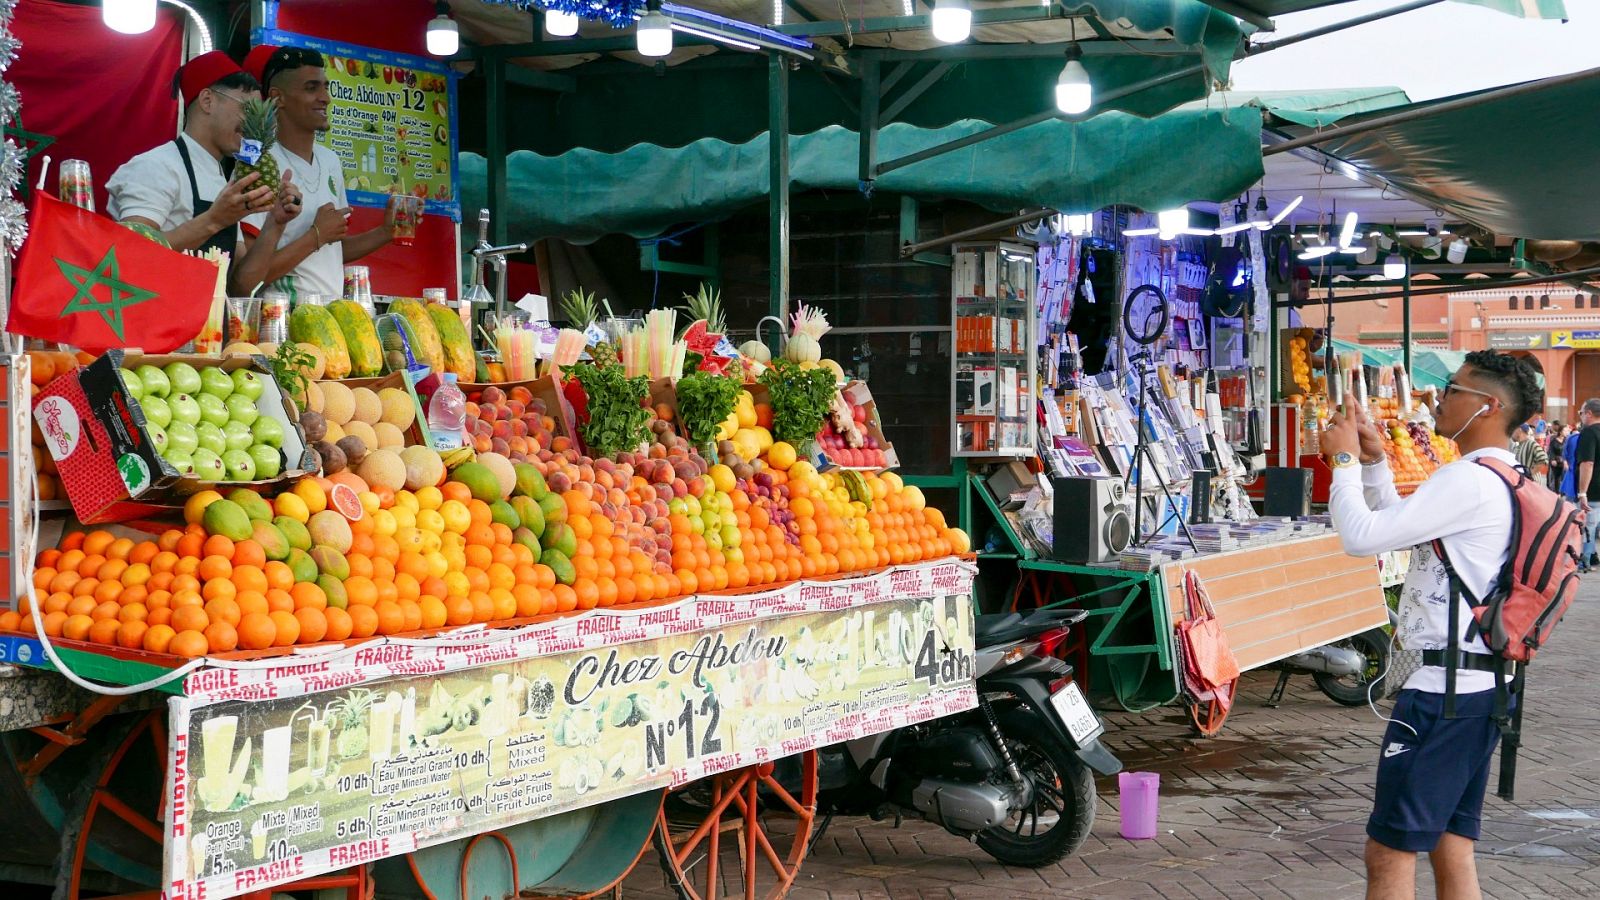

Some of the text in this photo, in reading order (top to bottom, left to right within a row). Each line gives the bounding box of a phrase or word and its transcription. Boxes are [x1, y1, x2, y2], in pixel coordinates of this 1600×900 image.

[329, 80, 353, 101] Chez
[356, 85, 385, 106] Abdou
[402, 88, 426, 112] 12
[331, 105, 397, 123] Jus d'Orange 4DH
[331, 127, 341, 135] Jus
[341, 161, 358, 170] Grand
[663, 618, 705, 635] FRAGILE
[819, 594, 854, 610] FRAGILE
[890, 580, 923, 594] FRAGILE
[931, 575, 962, 589] FRAGILE
[354, 644, 415, 667] FRAGILE
[576, 616, 622, 637] FRAGILE
[638, 606, 682, 627] FRAGILE
[696, 600, 736, 618] FRAGILE
[750, 593, 787, 610] FRAGILE
[800, 586, 834, 601] FRAGILE
[890, 570, 921, 584] FRAGILE
[931, 565, 960, 578] FRAGILE
[563, 627, 788, 706] Chez Abdou
[914, 629, 972, 687] 4dh
[843, 703, 851, 714] 10
[1066, 690, 1079, 706] 26
[784, 718, 792, 731] 10
[793, 716, 801, 728] dh
[505, 732, 546, 748] مختلط
[702, 752, 743, 776] FRAGILE
[860, 714, 895, 736] FRAGILE
[382, 746, 453, 769] ماء معدني كبير
[454, 750, 485, 769] 10 dh
[508, 753, 546, 770] Mixed
[509, 744, 546, 760] Mixte
[379, 757, 453, 782] Eau Mineral Grand
[529, 769, 553, 782] عصير
[172, 734, 187, 838] FRAGILE
[338, 773, 368, 793] 10 dh
[377, 771, 452, 795] Large Mineral Water
[490, 781, 553, 804] Jus de Fruits
[379, 788, 450, 813] ماء معدني صغير
[451, 795, 483, 811] 10 dh
[496, 793, 553, 813] Fruit Juice
[261, 811, 287, 829] Mixte
[292, 801, 319, 821] Mixed
[376, 800, 450, 828] Eau Mineral Petit
[207, 819, 241, 839] Orange
[337, 817, 366, 837] 5 dh
[329, 837, 390, 868] FRAGILE
[234, 855, 304, 892] FRAGILE
